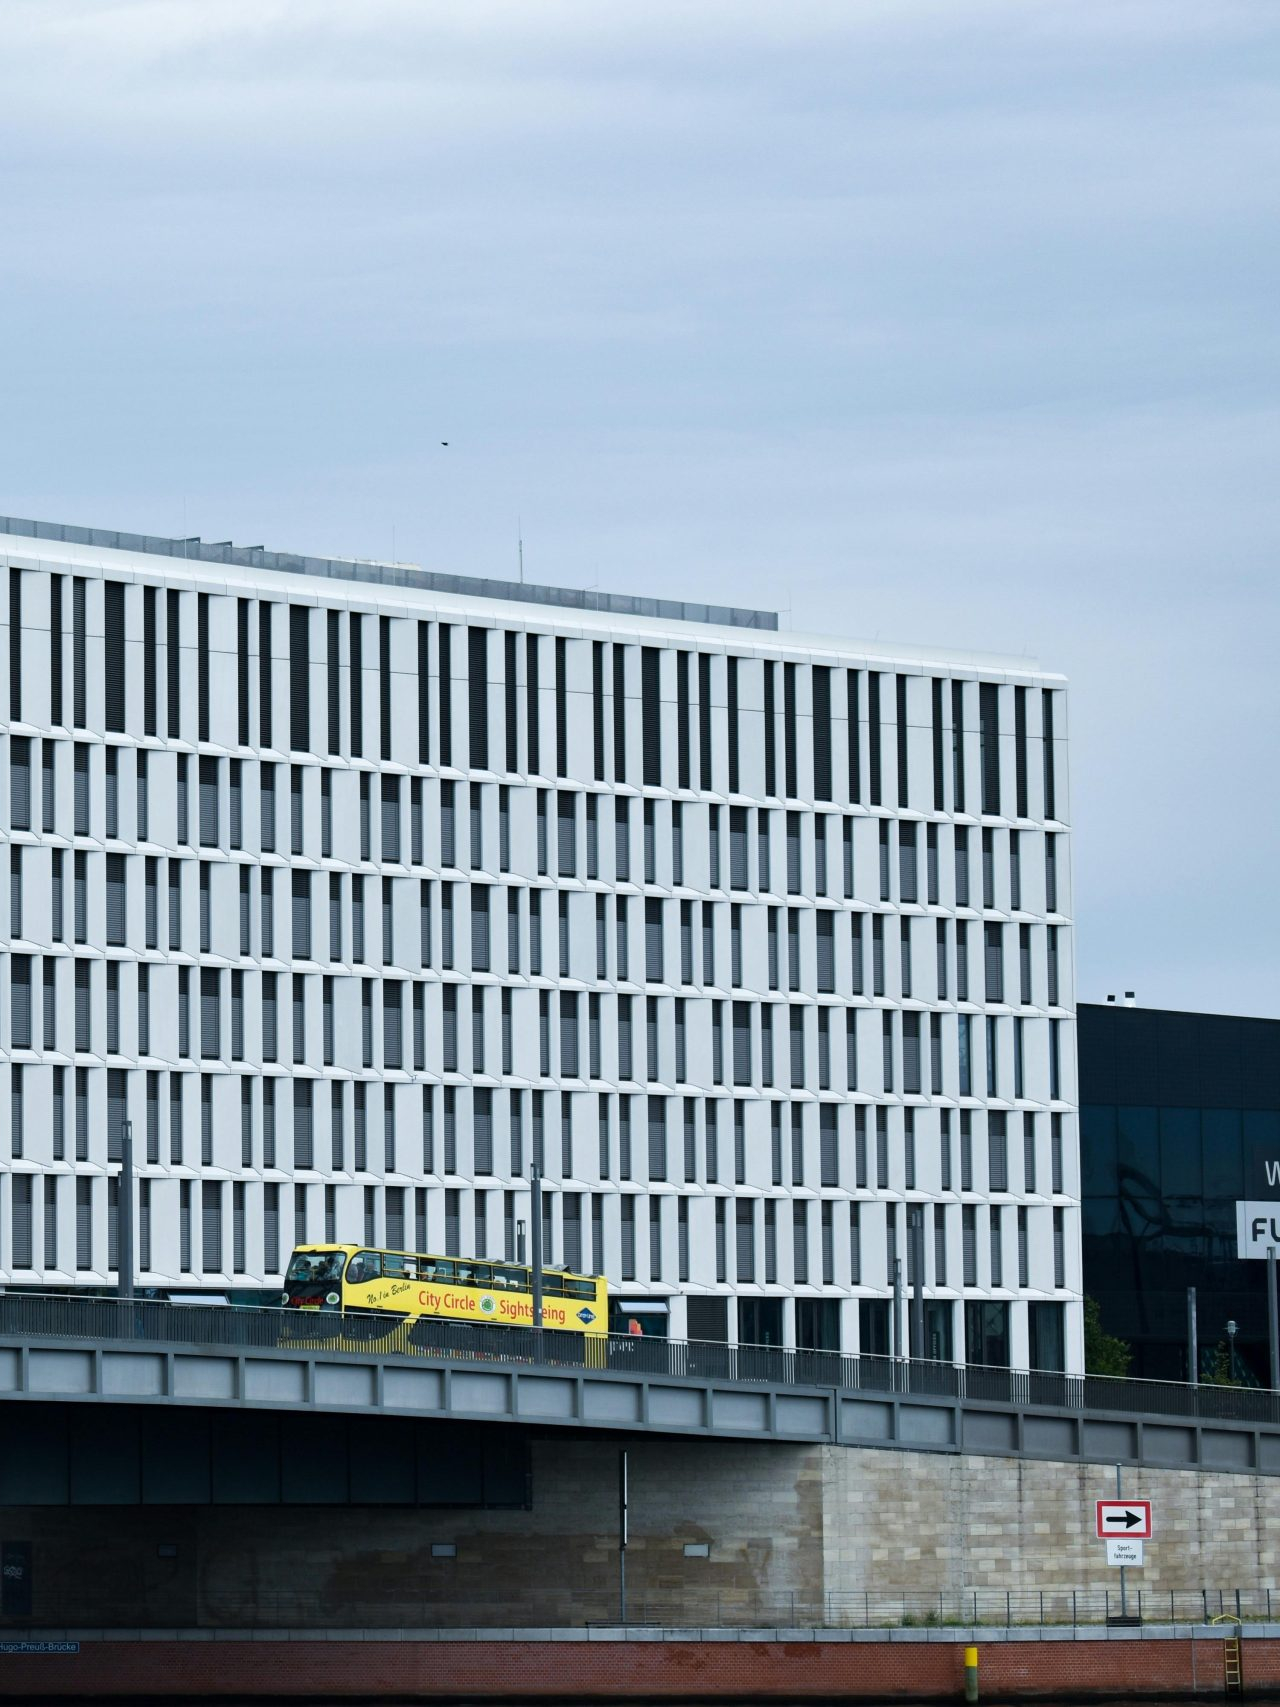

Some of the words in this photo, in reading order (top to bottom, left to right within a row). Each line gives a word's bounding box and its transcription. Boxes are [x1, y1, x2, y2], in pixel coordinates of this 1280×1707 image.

[391, 1282, 411, 1296] Berlin
[418, 1290, 441, 1311] City
[443, 1293, 476, 1312] Circle
[499, 1299, 566, 1325] Sightseing
